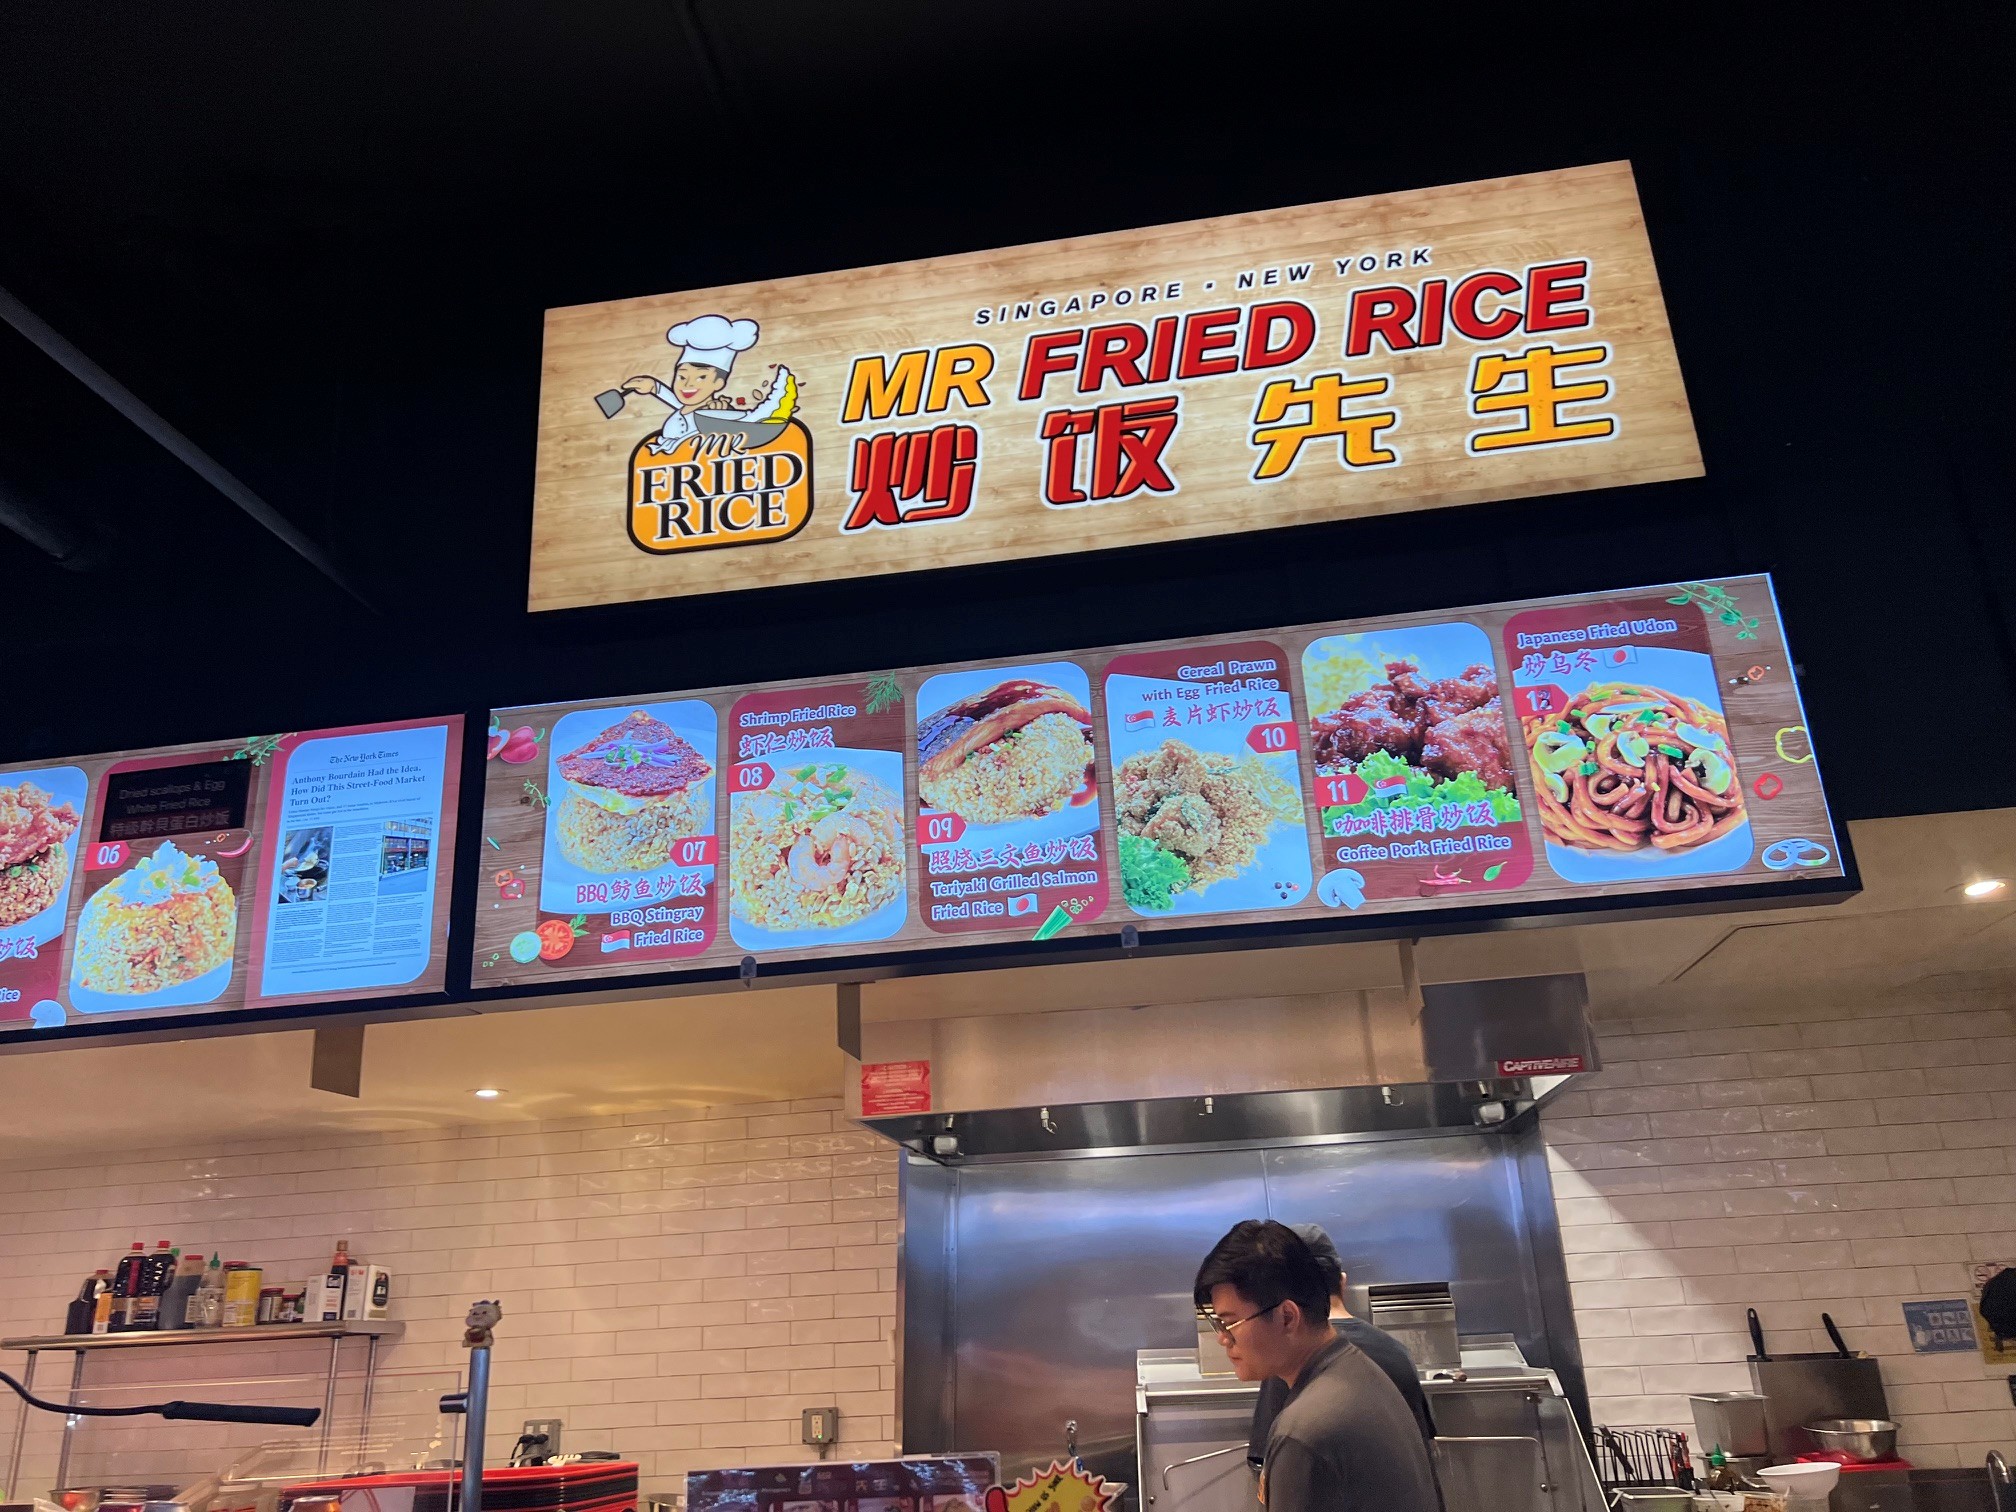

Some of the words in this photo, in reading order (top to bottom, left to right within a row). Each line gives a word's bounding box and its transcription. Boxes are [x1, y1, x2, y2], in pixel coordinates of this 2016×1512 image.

[975, 282, 1182, 325] SINGAPORE
[1237, 264, 1313, 289] NEW
[1336, 247, 1431, 275] YORK
[841, 344, 994, 423] MR
[1017, 300, 1316, 400] FRIED
[1345, 260, 1589, 357] RICE
[638, 452, 804, 505] FRIED
[654, 489, 787, 540] RICE
[1517, 630, 1585, 648] Japanese
[1589, 623, 1630, 639] Fried
[1633, 619, 1677, 634] Udon
[1179, 663, 1224, 679] Cereal
[1230, 659, 1276, 674] Prawn
[1524, 649, 1598, 679] 炒乌冬
[1142, 689, 1172, 702] with
[1177, 686, 1200, 701] Egg
[1205, 681, 1241, 696] Fried
[1248, 678, 1278, 692] Rice
[741, 711, 789, 726] Shrimp
[791, 706, 825, 721] Fried
[828, 704, 856, 718] Rice
[1162, 696, 1281, 728] 麦片虾炒饭
[740, 727, 834, 757] 虾仁炒饭
[1261, 727, 1287, 749] 10
[377, 750, 399, 760] Times
[193, 780, 202, 791] &
[204, 780, 226, 792] Egg
[291, 787, 310, 796] How
[311, 784, 326, 794] Did
[328, 782, 345, 792] This
[346, 777, 394, 791] Street-Food
[395, 774, 426, 786] Market
[293, 775, 326, 785] Anthony
[328, 770, 366, 781] Bourdain
[367, 767, 384, 777] Had
[386, 767, 399, 775] the
[739, 767, 762, 787] 08
[290, 798, 309, 807] Turn
[310, 794, 332, 804] Out?
[1327, 780, 1349, 802] 11
[159, 800, 187, 811] Fried
[188, 797, 211, 808] Rice
[929, 817, 953, 839] 09
[1335, 801, 1497, 835] 咖啡排骨炒饭
[97, 844, 121, 866] 06
[683, 841, 706, 862] 07
[930, 837, 1097, 872] 照烧三文鱼炒饭
[1338, 844, 1388, 861] Coffee
[1391, 840, 1430, 857] Pork
[1432, 838, 1472, 854] Fried
[1476, 835, 1511, 851] Rice
[932, 879, 986, 897] Teriyaki
[990, 873, 1039, 891] Grilled
[1043, 870, 1097, 886] Salmon
[612, 910, 645, 926] BBQ
[646, 907, 703, 922] Stingray
[932, 902, 970, 920] Fried
[973, 900, 1004, 915] Rice
[635, 930, 672, 946] Fried
[675, 928, 703, 943] Rice
[0, 987, 20, 1002] ice
